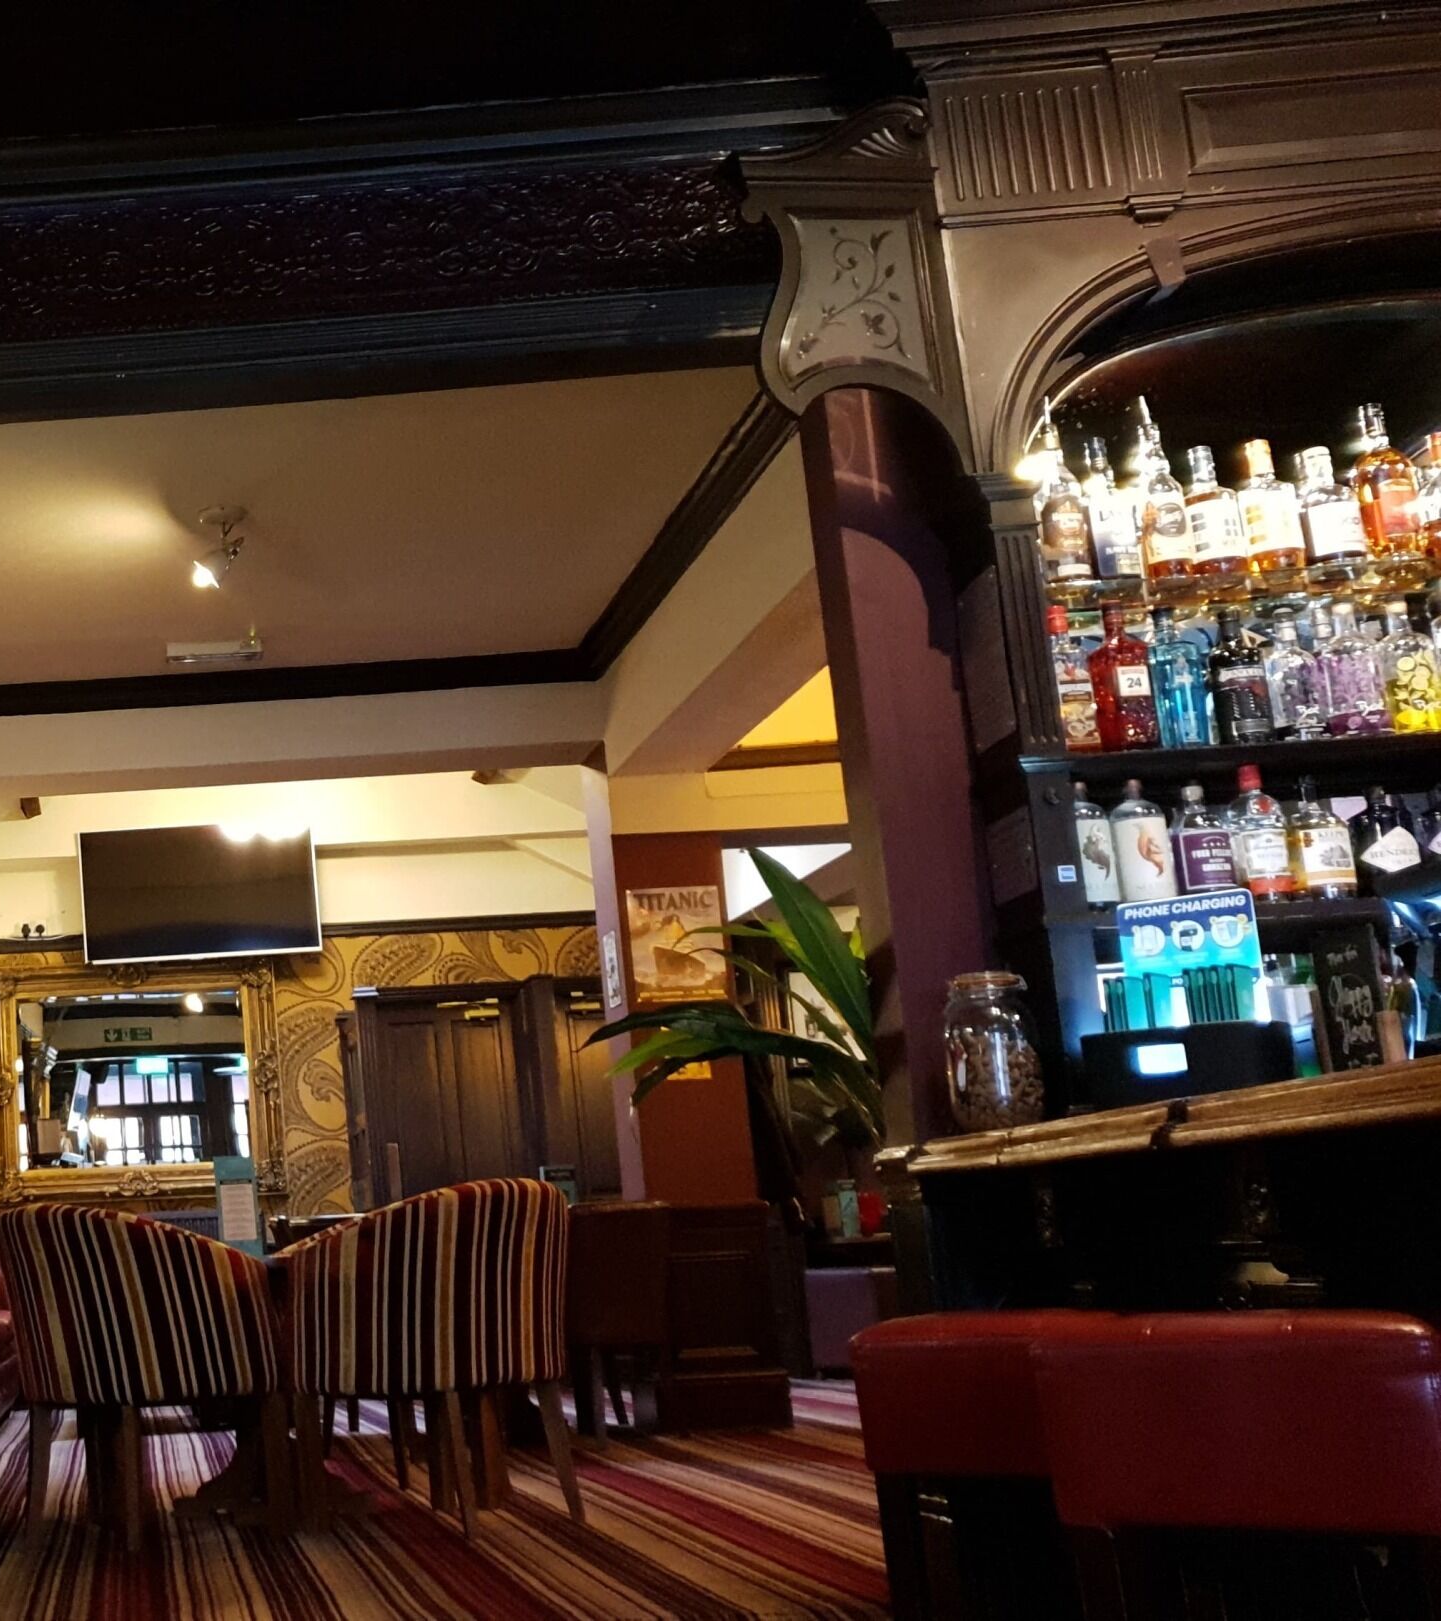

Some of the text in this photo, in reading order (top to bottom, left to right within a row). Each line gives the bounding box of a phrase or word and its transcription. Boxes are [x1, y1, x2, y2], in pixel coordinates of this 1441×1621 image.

[1126, 677, 1142, 689] 24
[633, 890, 714, 912] TITANIC
[1124, 894, 1247, 920] PHONE CHARGING
